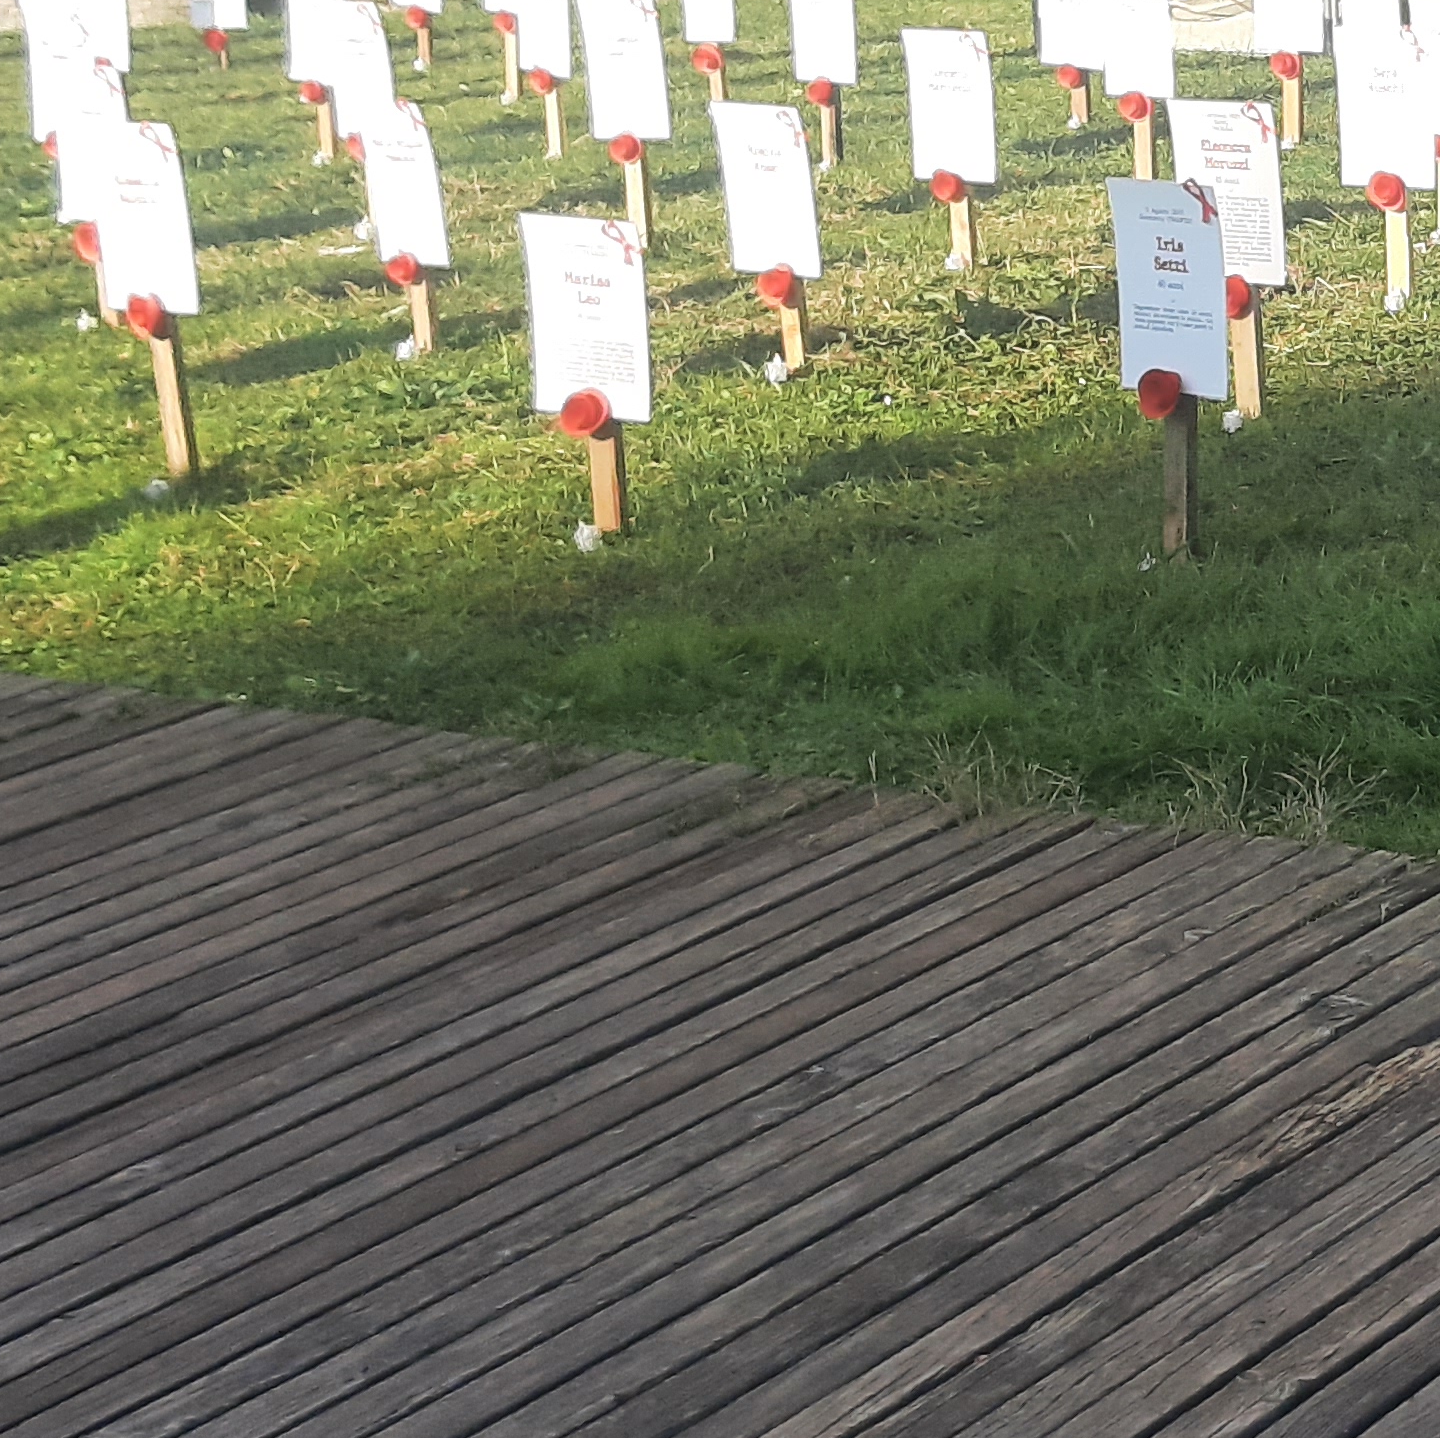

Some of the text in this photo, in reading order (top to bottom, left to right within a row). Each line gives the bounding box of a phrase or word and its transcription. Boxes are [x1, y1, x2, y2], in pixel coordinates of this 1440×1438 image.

[1155, 236, 1185, 253] Iris
[1153, 255, 1190, 274] Setti
[577, 290, 601, 305] Leo
